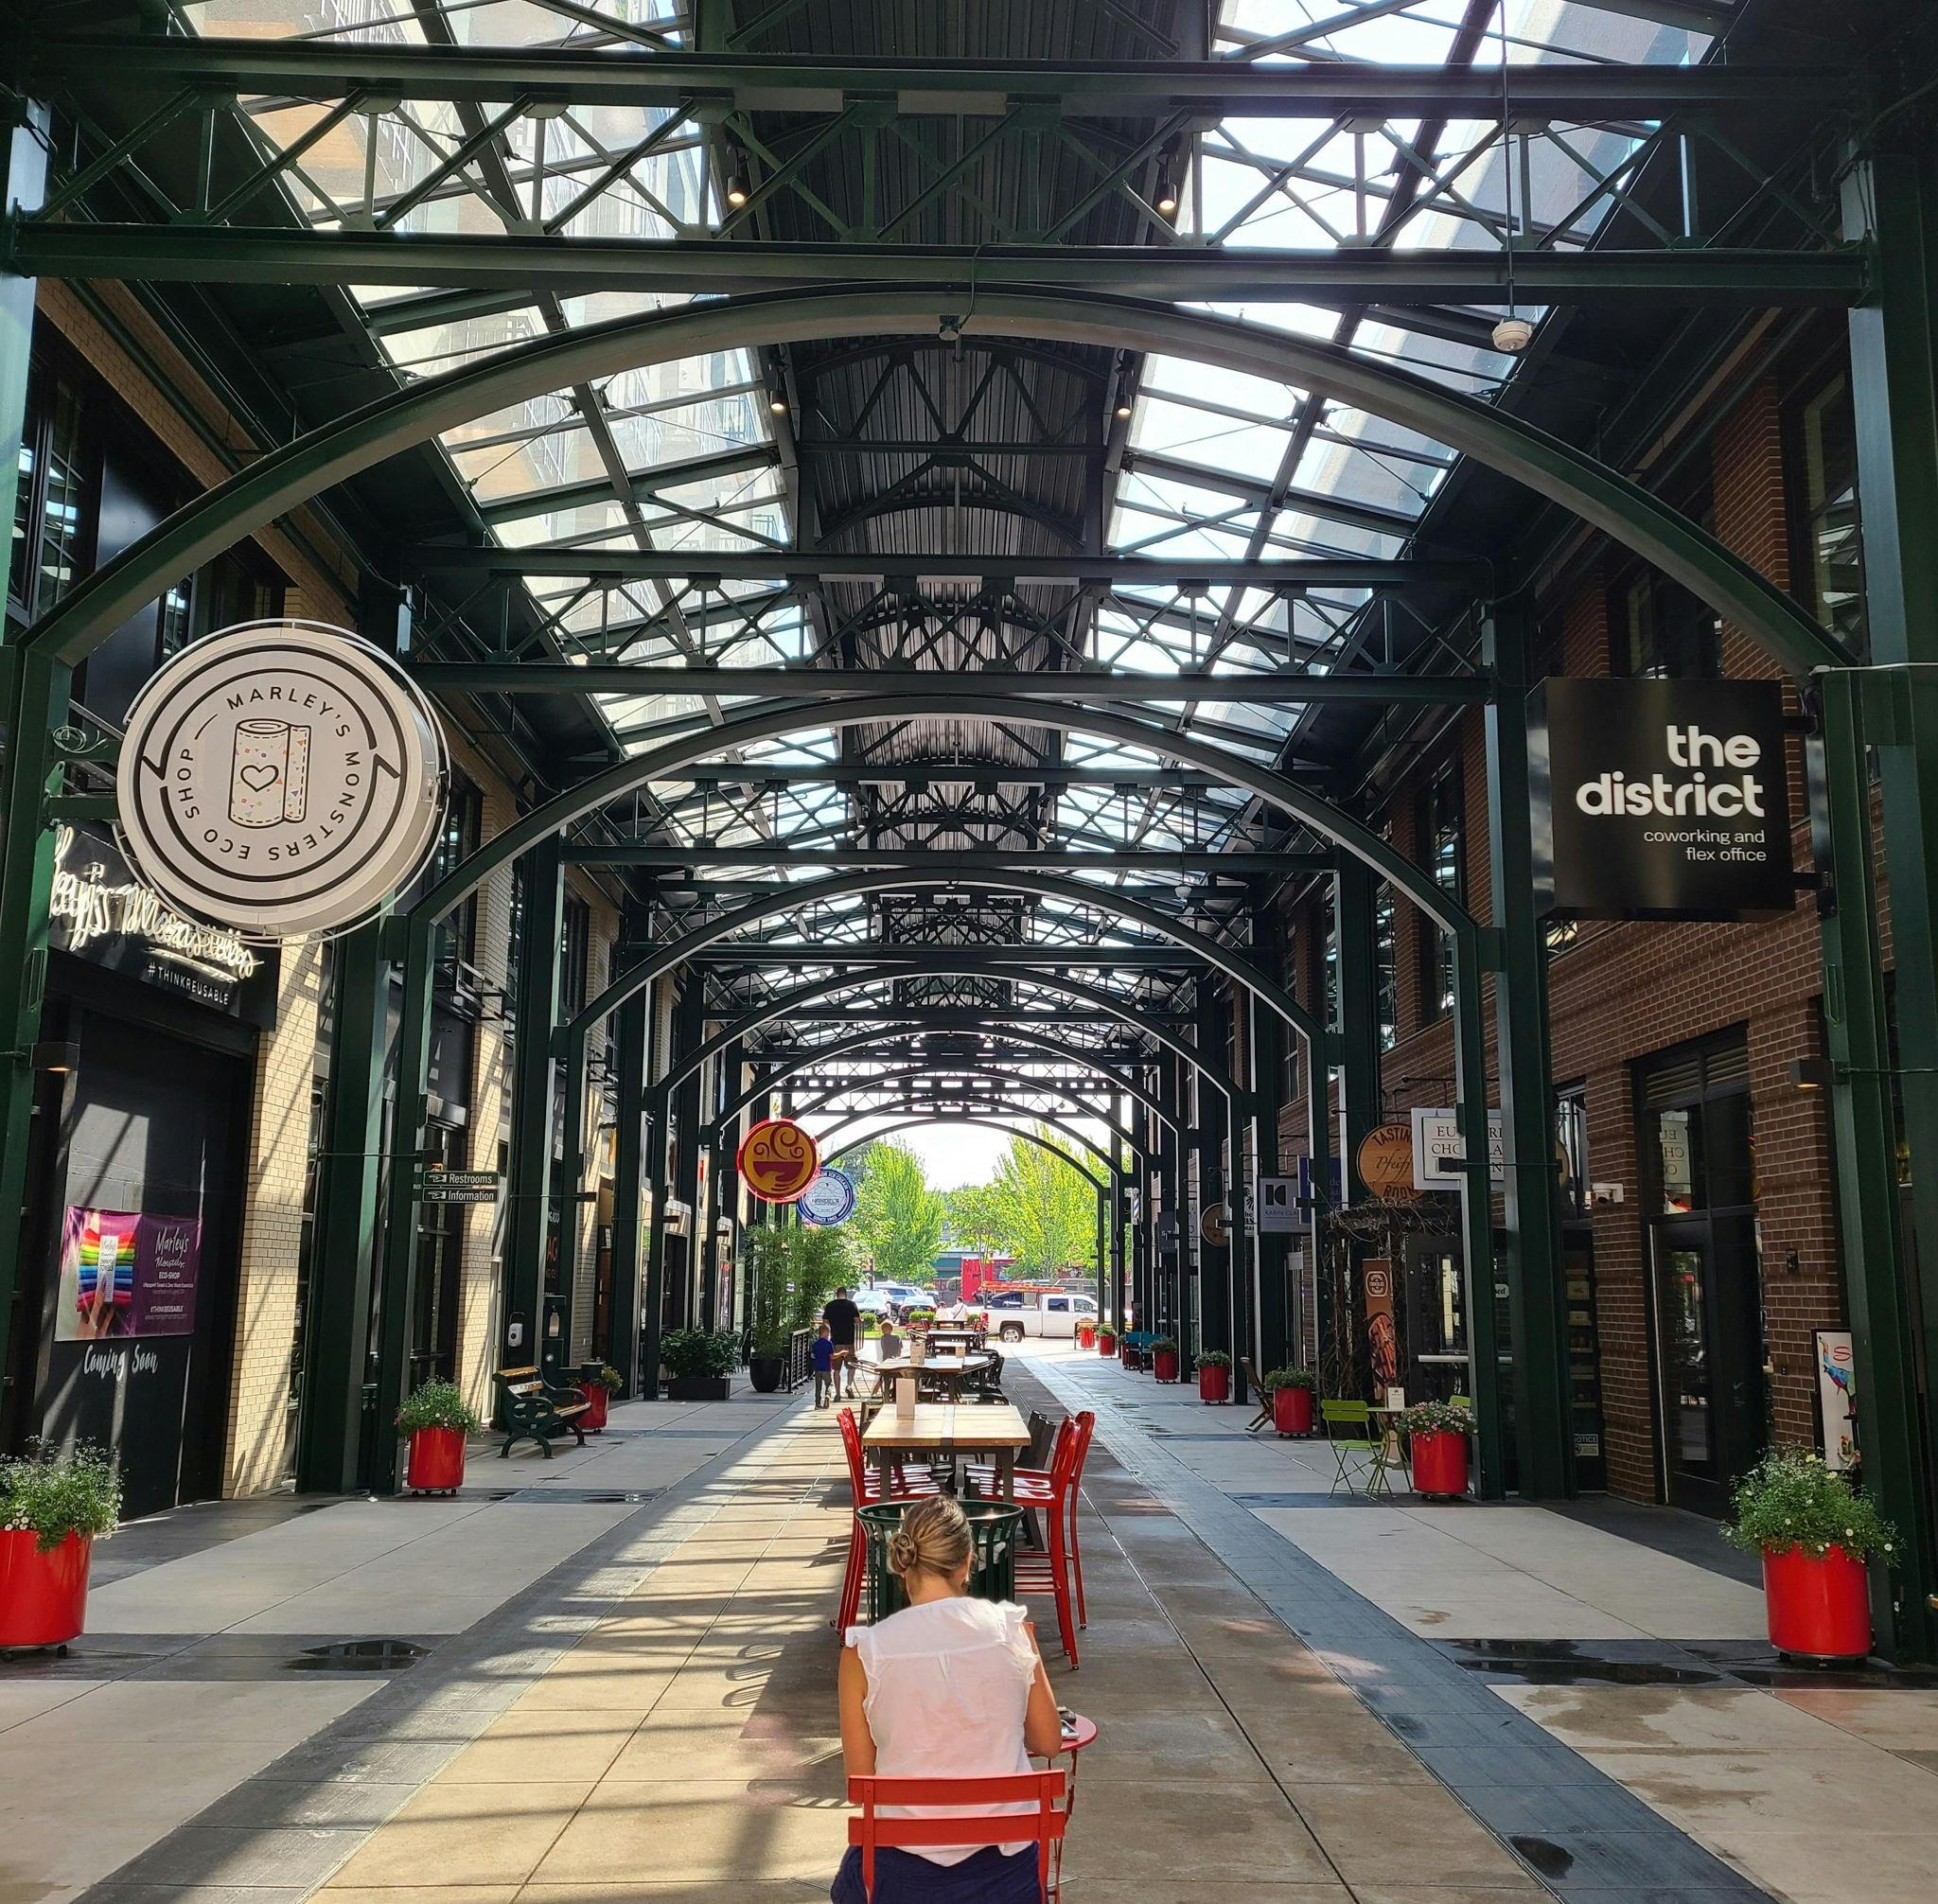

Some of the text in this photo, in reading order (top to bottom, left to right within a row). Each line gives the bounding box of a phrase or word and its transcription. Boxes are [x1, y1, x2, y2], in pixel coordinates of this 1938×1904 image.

[1665, 724, 1762, 768] the
[176, 685, 361, 861] MARLEY'S MONSTERS ECO SHOP
[1575, 770, 1766, 818] district
[1643, 828, 1766, 845] coworking and
[1684, 846, 1768, 862] flex office
[147, 961, 230, 1006] #THINKREUSABLE
[1371, 1126, 1411, 1147] TASTIN
[449, 1172, 493, 1184] Restrooms
[448, 1190, 494, 1201] Information
[154, 1225, 189, 1259] Marley's
[83, 1344, 159, 1382] Coming Soon
